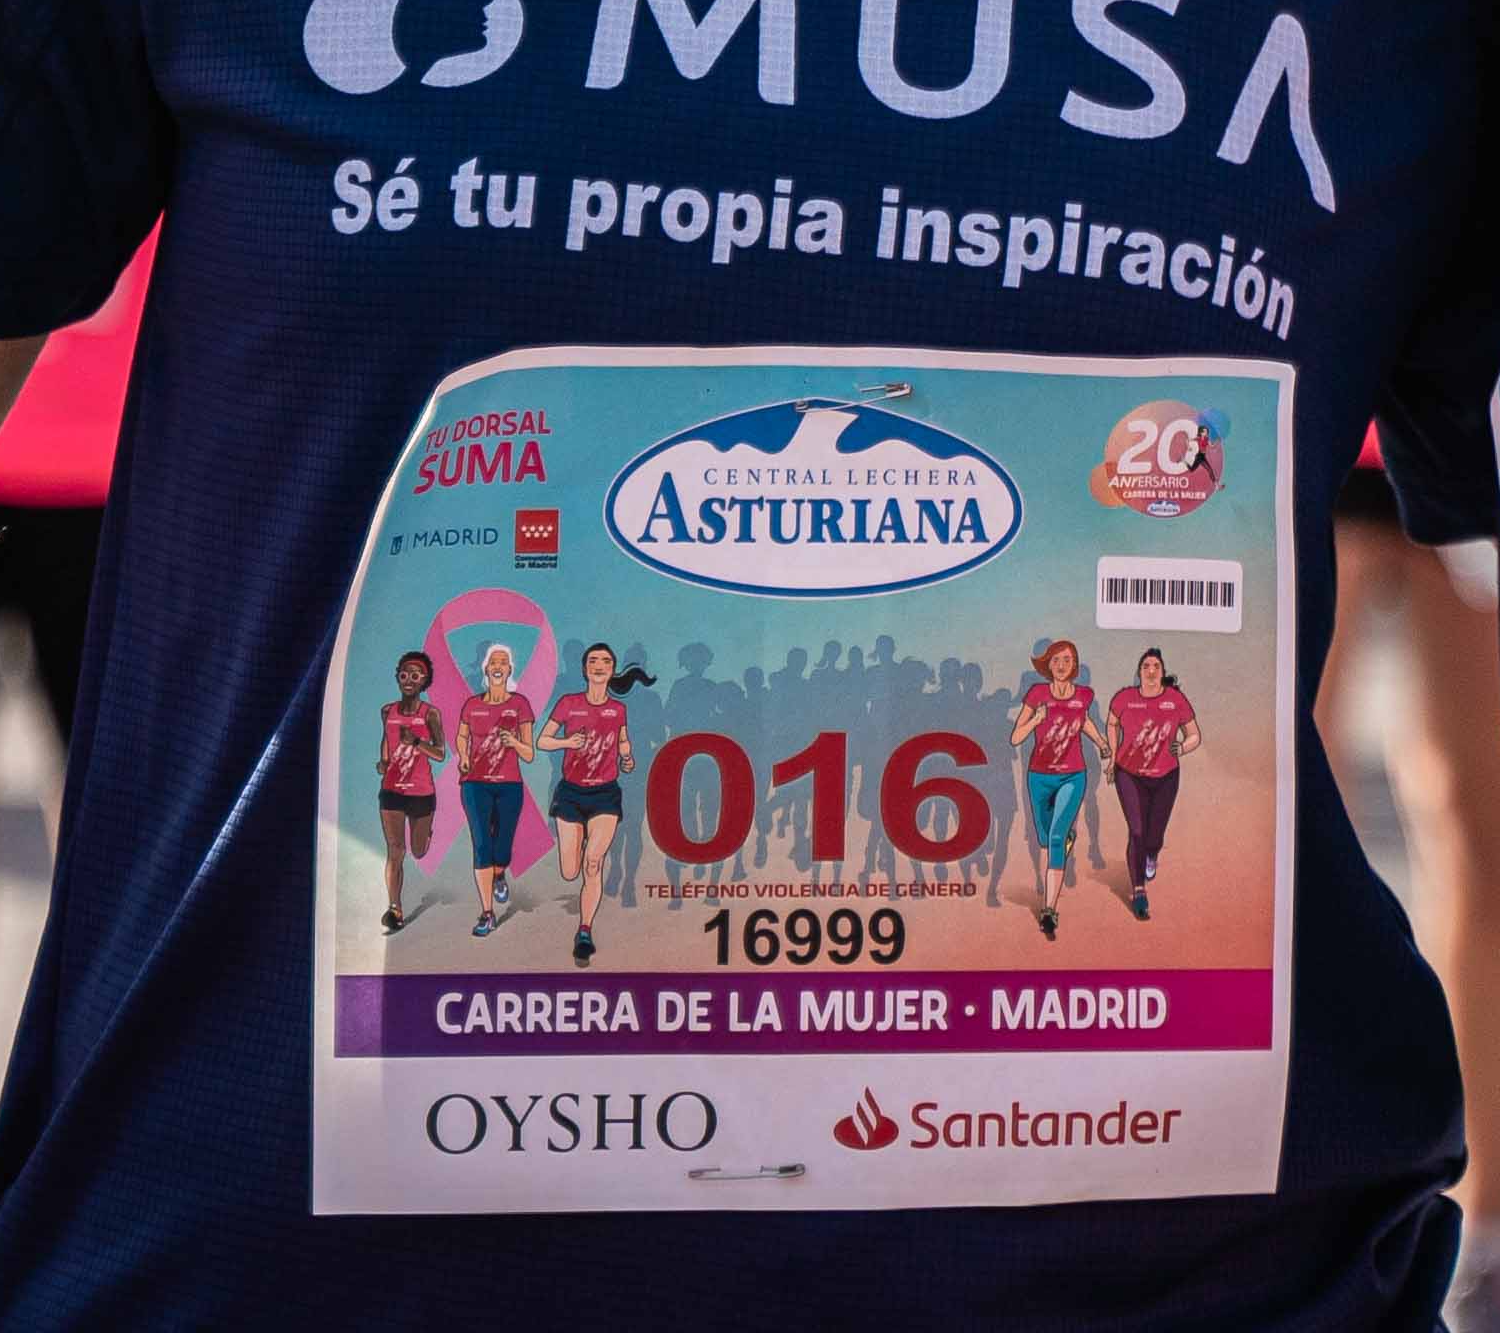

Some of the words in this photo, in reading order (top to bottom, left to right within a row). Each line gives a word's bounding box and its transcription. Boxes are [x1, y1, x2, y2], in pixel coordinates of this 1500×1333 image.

[330, 157, 418, 235] Sé
[448, 157, 536, 229] tu
[565, 175, 844, 265] propia
[876, 185, 1295, 342] inspiración
[426, 426, 449, 453] TU
[452, 410, 551, 443] DORSAL
[1117, 419, 1199, 475] 20
[413, 440, 547, 495] SUMA
[704, 468, 832, 486] CENTRAL
[848, 468, 977, 486] LECHERA
[637, 471, 990, 545] ASTURIANA
[413, 528, 498, 549] MADRID
[646, 731, 991, 865] 016
[645, 881, 749, 898] TELÉFONO
[755, 883, 859, 898] VIOLENCIA
[866, 883, 889, 898] DE
[895, 880, 977, 897] GÉNERO
[704, 907, 906, 966] 16999
[435, 990, 639, 1034] CARRERA
[657, 990, 711, 1033] DE
[729, 990, 782, 1033] LA
[800, 989, 948, 1032] MUJER
[990, 988, 1168, 1031] MADRID
[425, 1090, 718, 1155] OYSHO
[910, 1100, 1182, 1150] Santander
